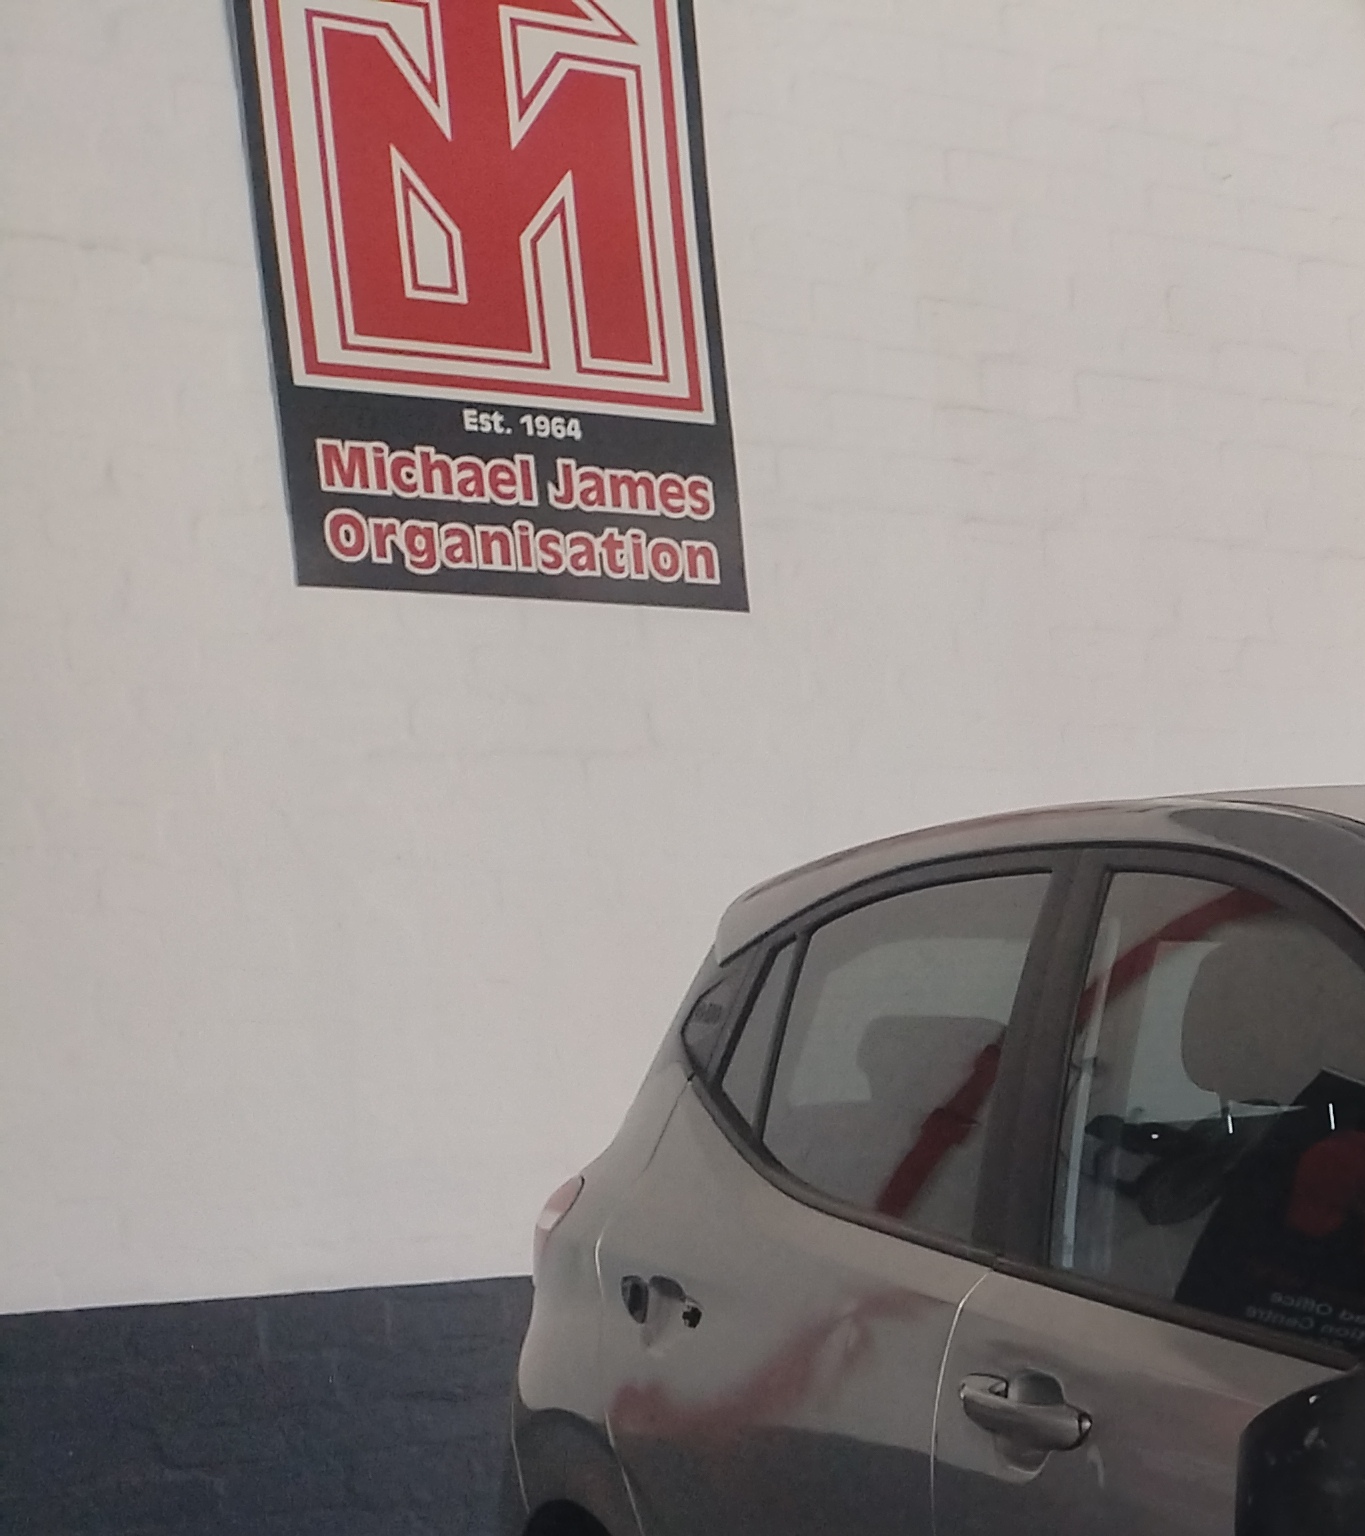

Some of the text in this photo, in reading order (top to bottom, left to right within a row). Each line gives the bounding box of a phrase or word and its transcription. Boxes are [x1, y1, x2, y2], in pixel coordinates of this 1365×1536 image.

[463, 409, 583, 441] Est. 1964
[315, 438, 715, 521] Michael James
[324, 507, 721, 585] Organisation
